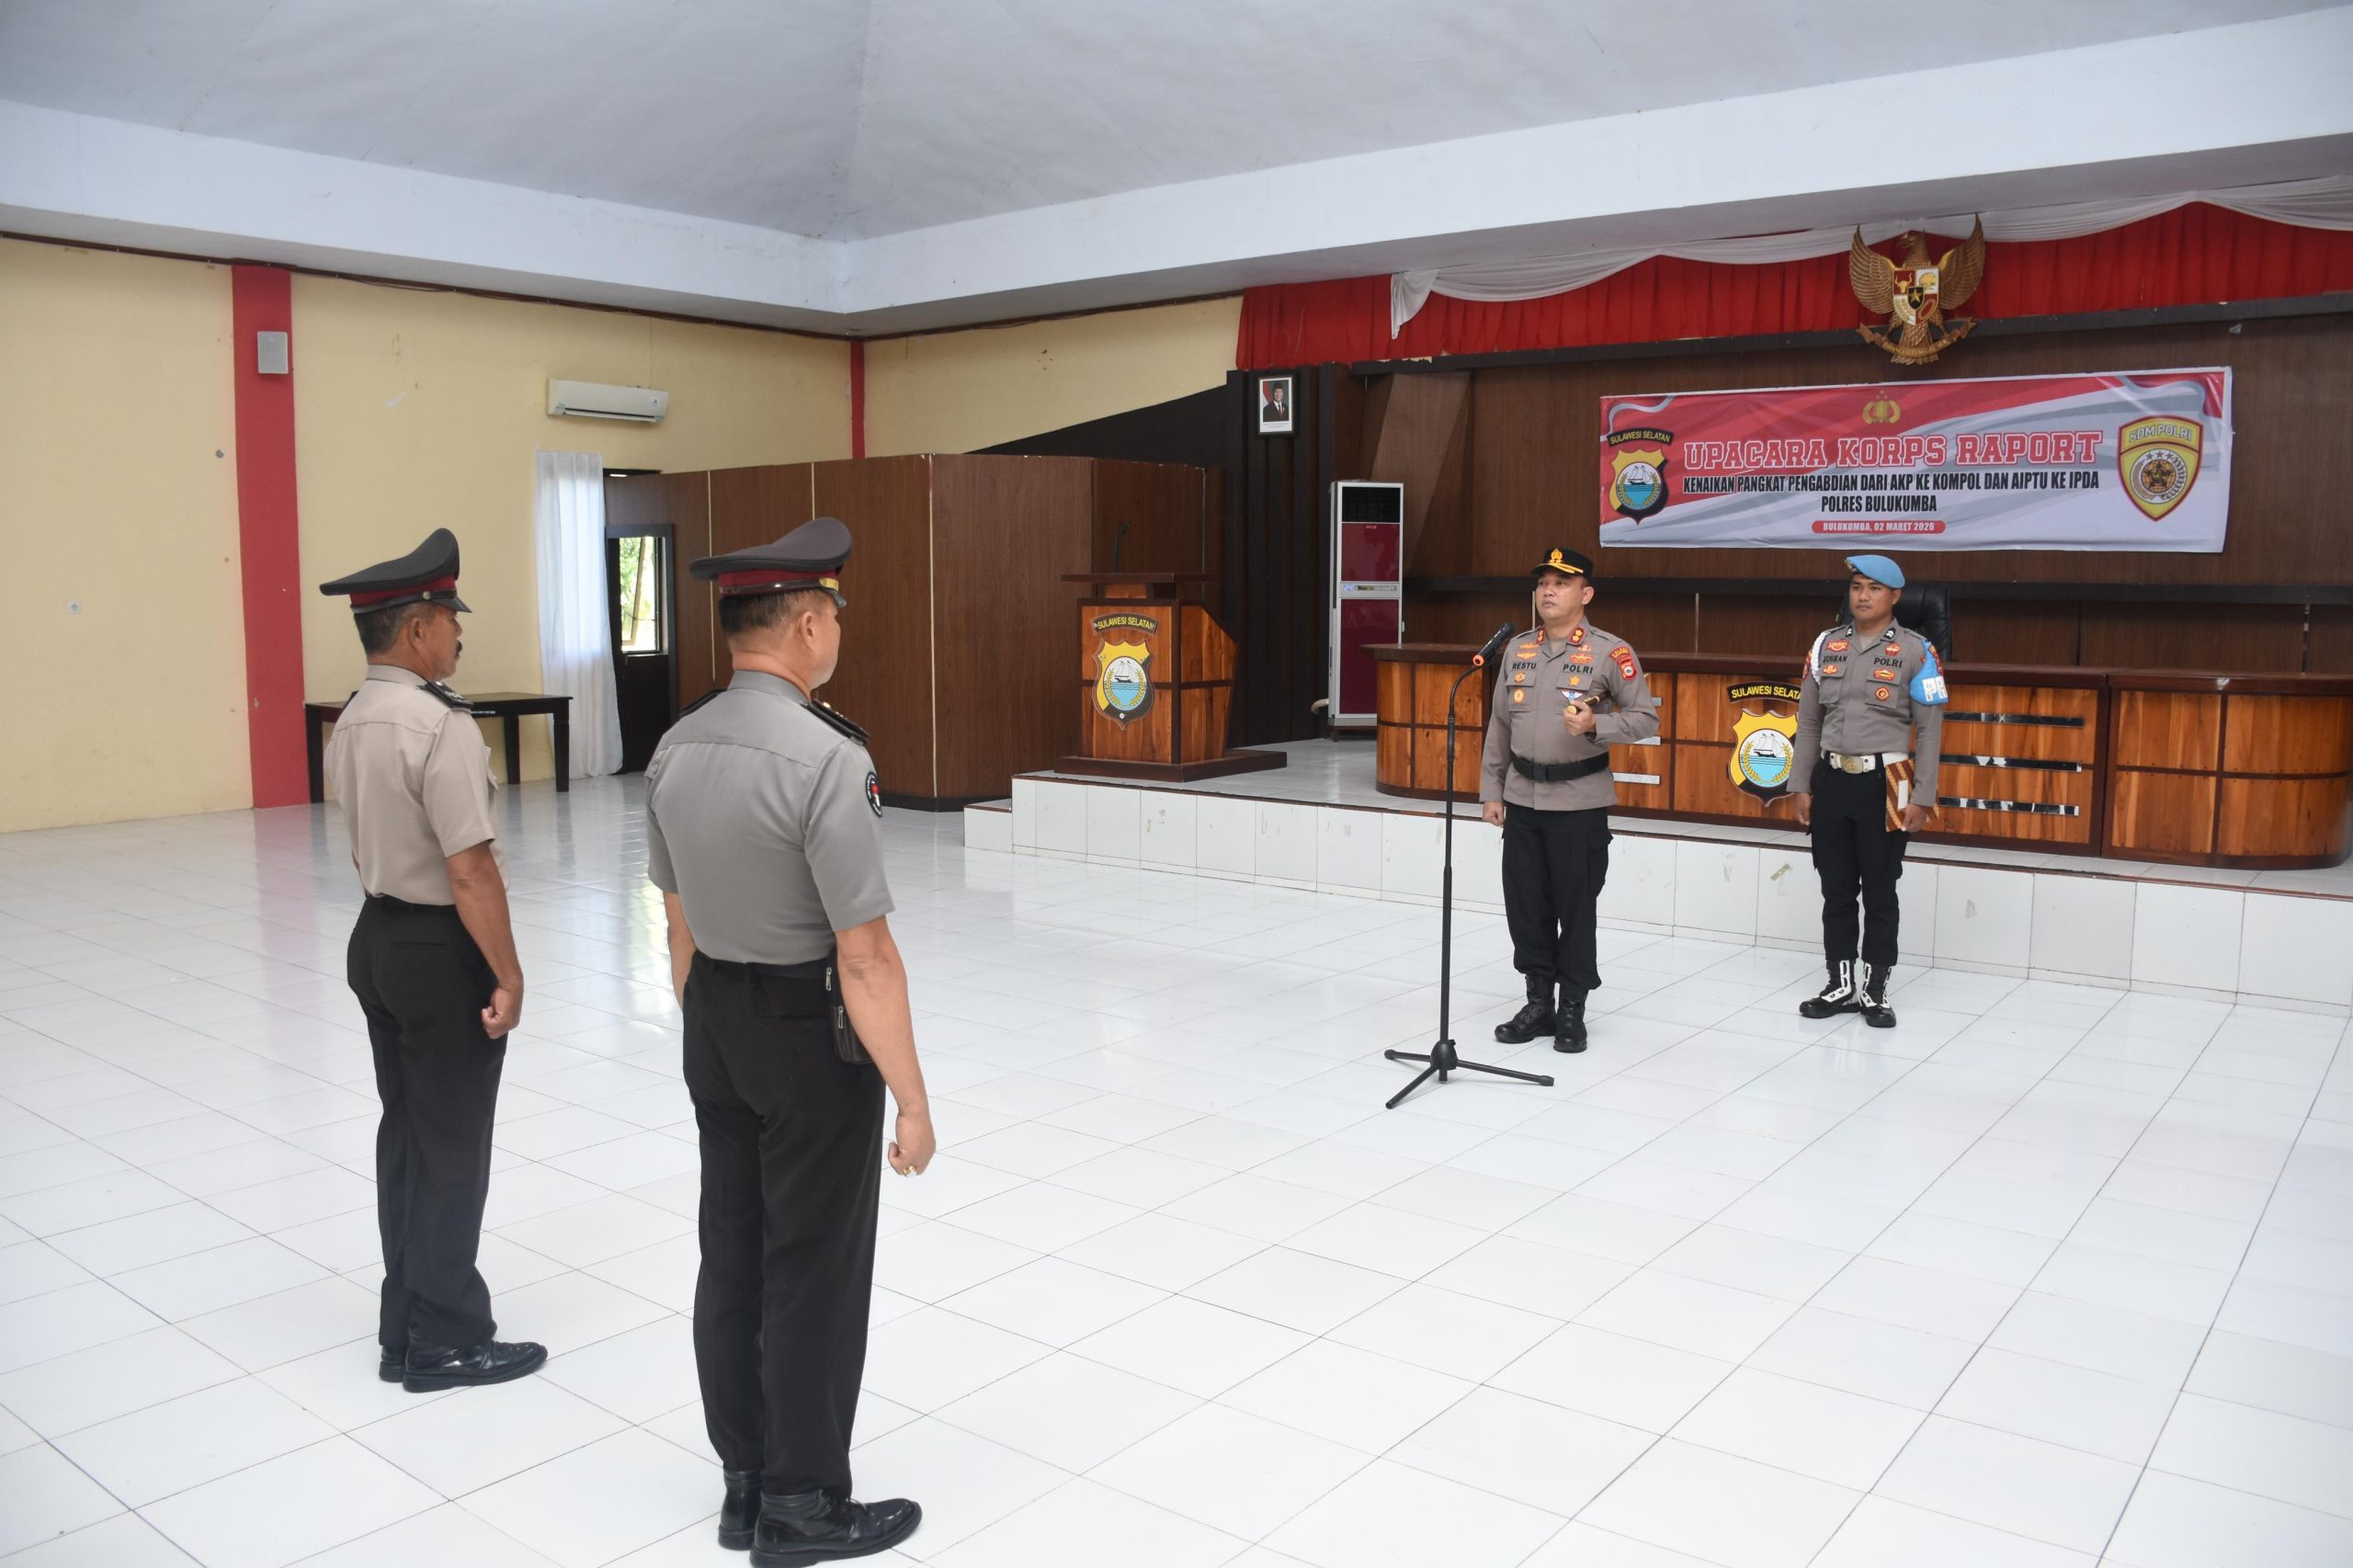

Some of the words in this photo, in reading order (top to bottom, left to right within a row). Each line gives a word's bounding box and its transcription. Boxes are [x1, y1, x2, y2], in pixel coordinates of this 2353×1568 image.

[1610, 431, 1642, 444] SULAWESI
[1643, 430, 1671, 443] SELATAN
[2130, 426, 2155, 441] SDM
[2157, 425, 2191, 441] POLRI
[1684, 439, 1827, 470] UPACARA
[1836, 435, 1947, 468] KORPS
[1956, 430, 2103, 466] RAPORT
[1683, 476, 1735, 493] KENAIKAN
[1737, 475, 1786, 493] PANGKAT
[1788, 474, 1858, 492] PENGABDIAN
[1860, 473, 1888, 491] DARI
[1890, 473, 1914, 491] AKP
[1915, 473, 1930, 491] KE
[1932, 472, 1981, 490] KOMPOL
[1984, 472, 2008, 490] DAN
[2011, 472, 2048, 489] AIPTU
[2051, 472, 2066, 489] KE
[2069, 471, 2099, 489] IPDA
[1821, 495, 1862, 512] POLRES
[1865, 494, 1937, 512] BULUKUMBA
[1874, 522, 1884, 531] 02
[1886, 522, 1913, 531] MARET
[1097, 617, 1127, 630] SULAWESI
[1128, 617, 1154, 631] SELATAN
[1512, 662, 1537, 670] RESTU
[1563, 664, 1593, 675] POLRI
[1873, 657, 1903, 668] POLRI
[1731, 686, 1772, 699] SULAWESI
[1773, 686, 1802, 699] SELATA
